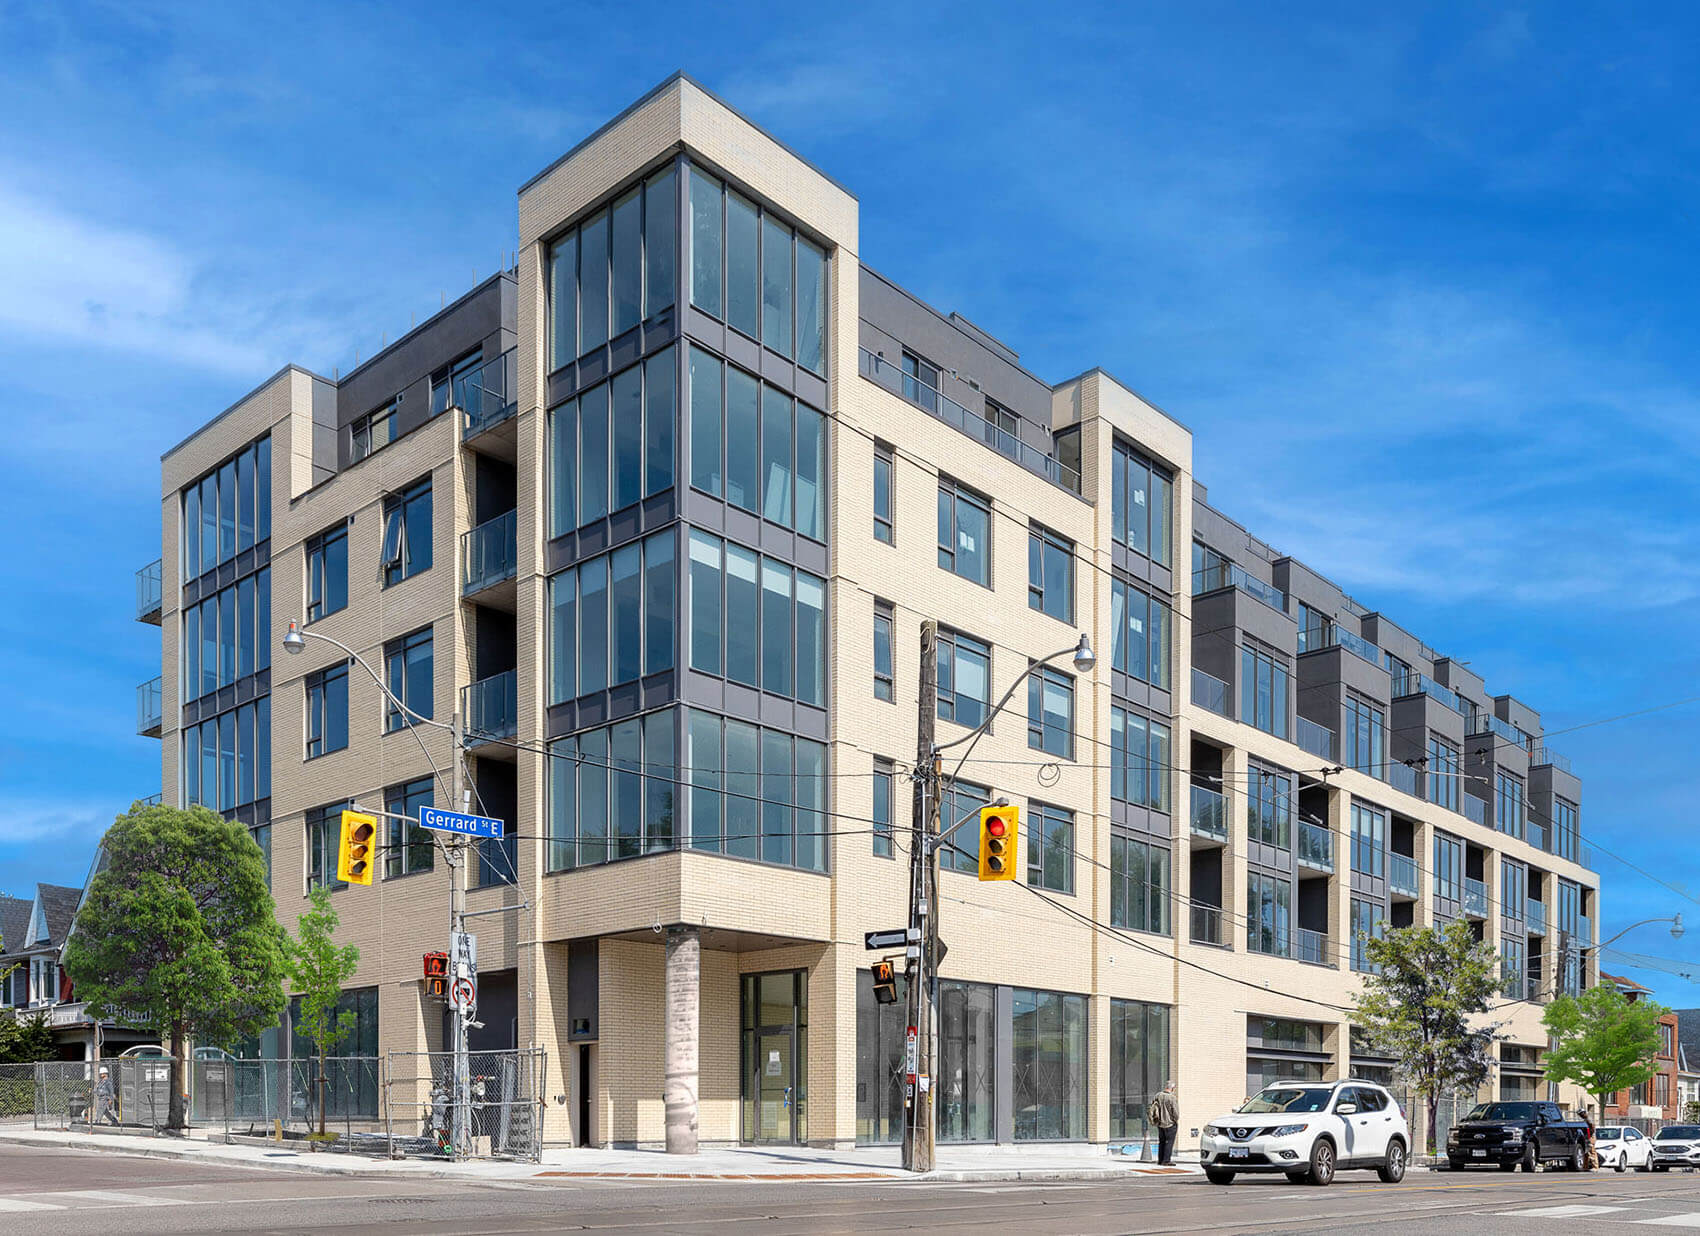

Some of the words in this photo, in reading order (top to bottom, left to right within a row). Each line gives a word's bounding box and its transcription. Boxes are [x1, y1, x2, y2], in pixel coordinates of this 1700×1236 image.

[425, 811, 477, 832] Gerrard
[481, 820, 489, 828] St
[491, 822, 498, 835] E
